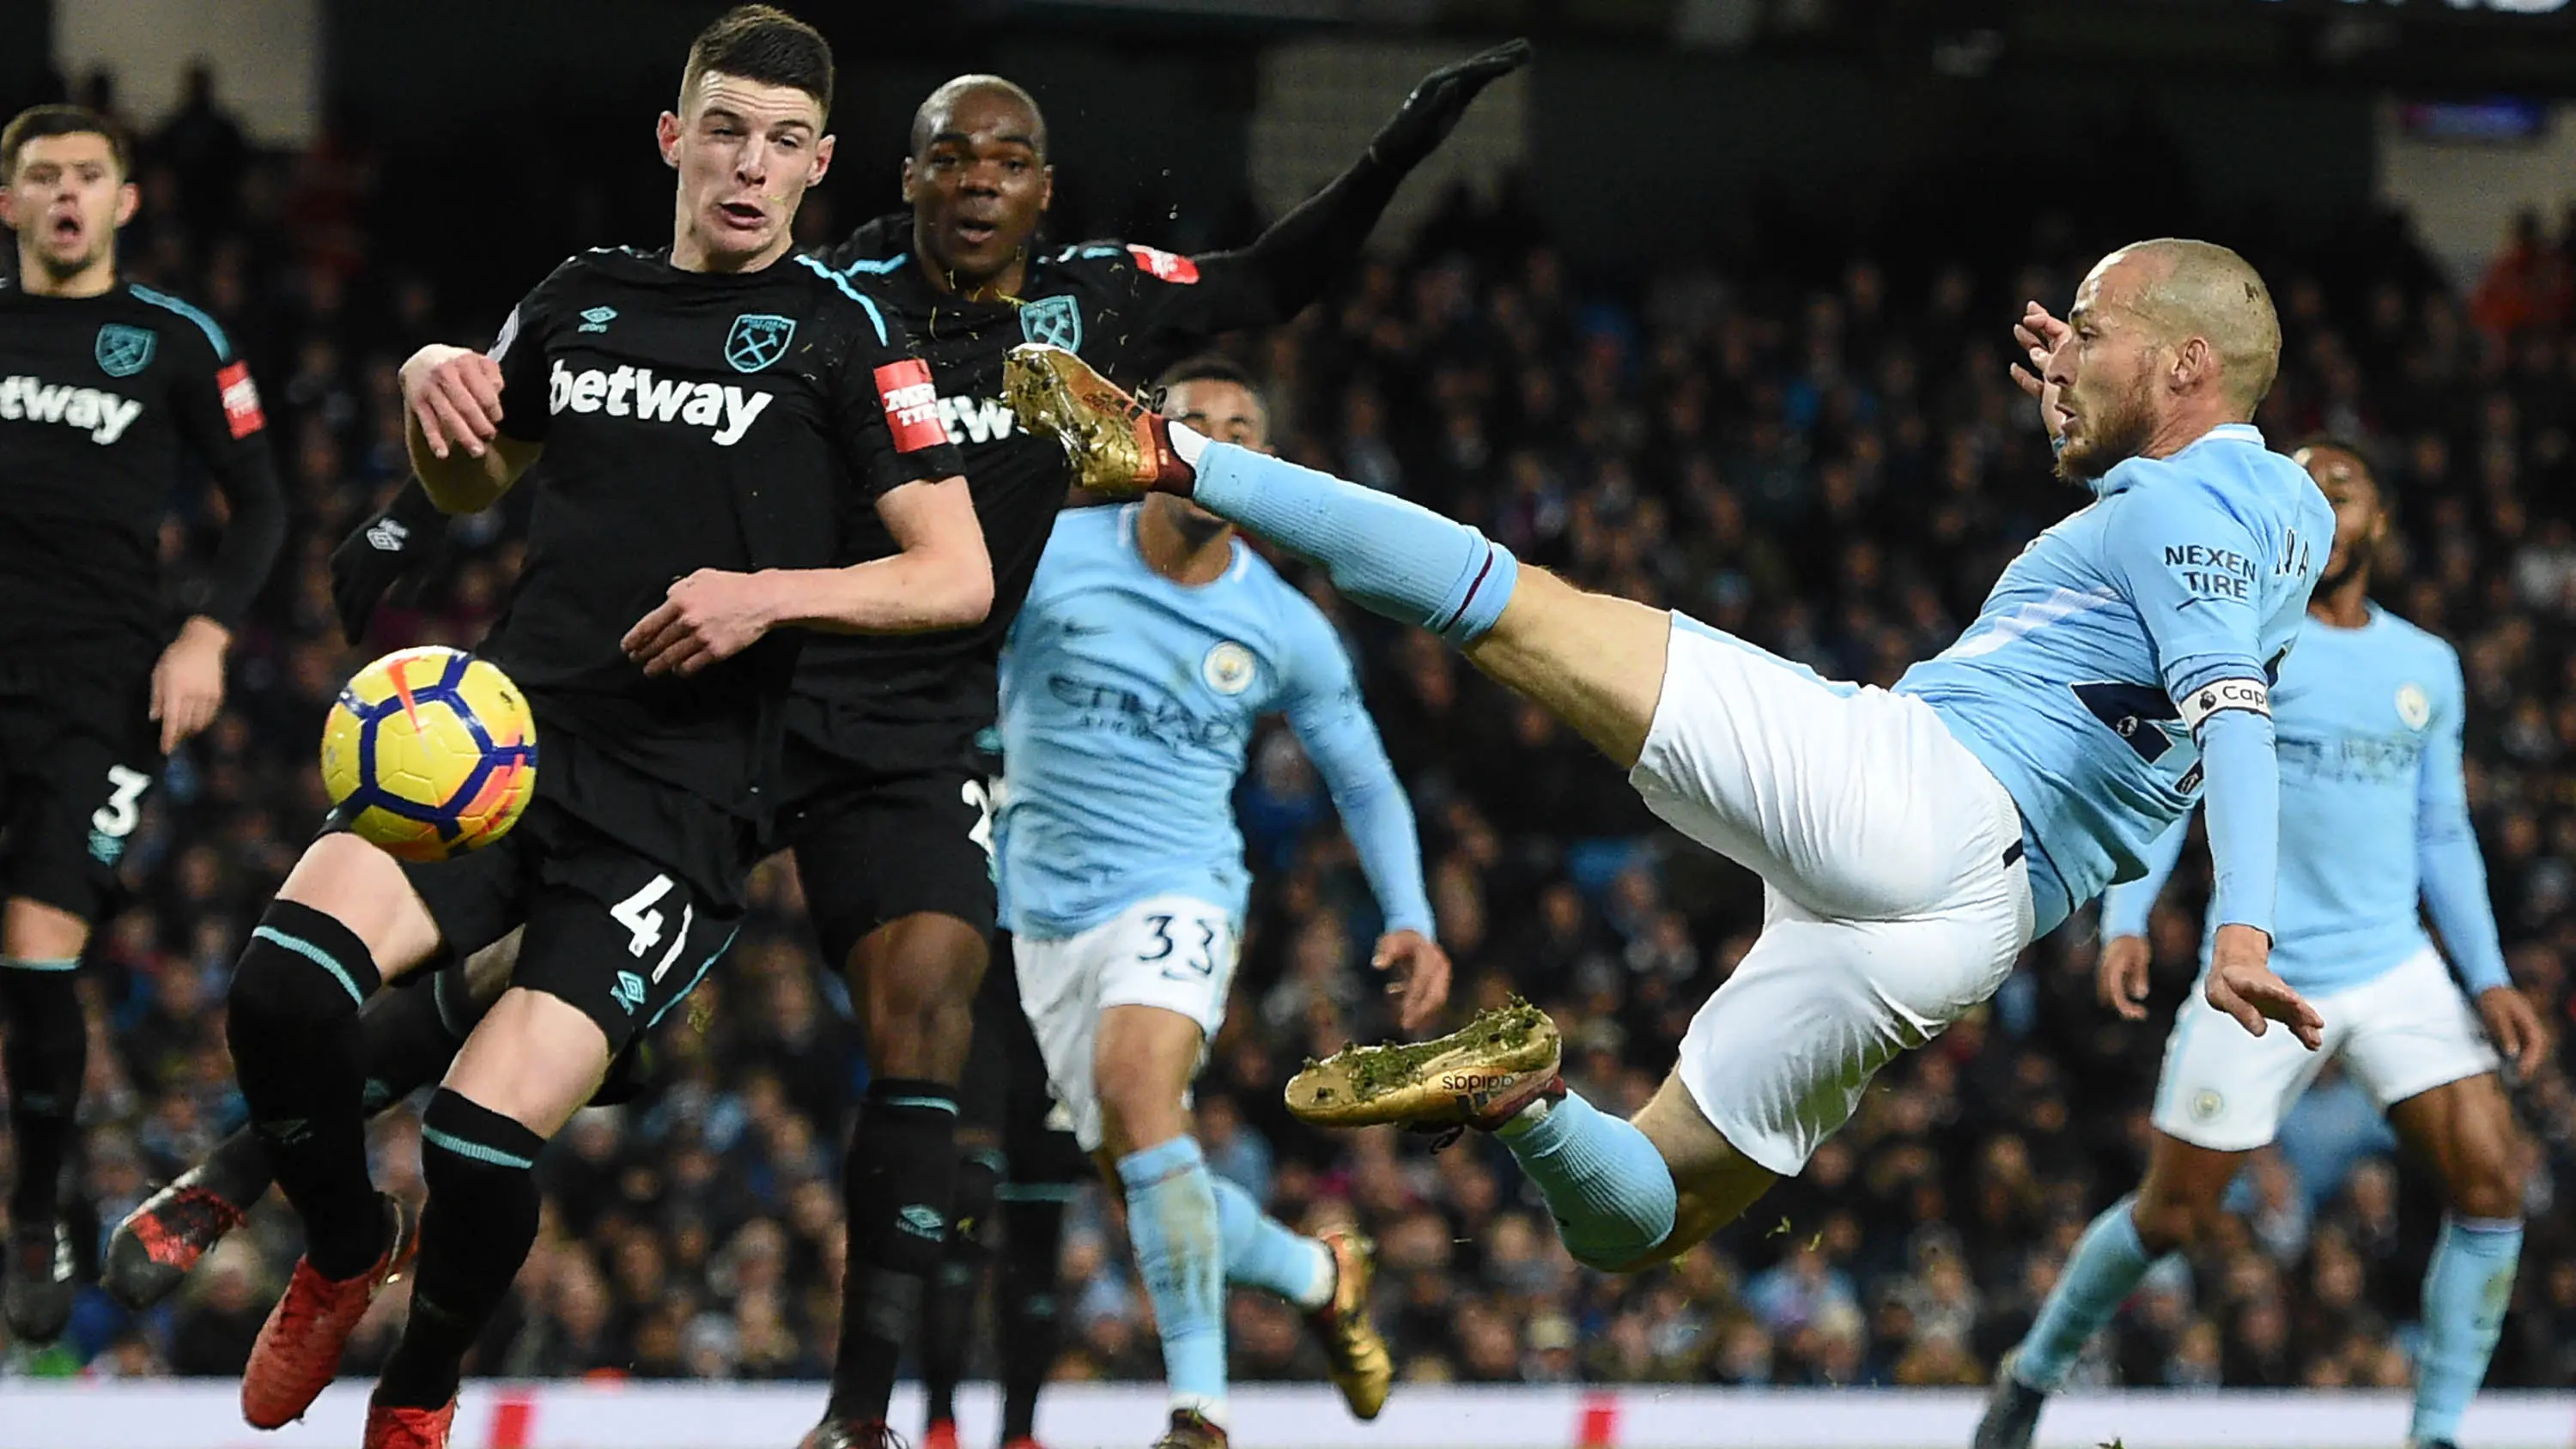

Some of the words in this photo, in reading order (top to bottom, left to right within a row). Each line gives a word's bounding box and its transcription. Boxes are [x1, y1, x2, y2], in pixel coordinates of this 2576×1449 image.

[550, 359, 774, 446] betway
[937, 394, 1030, 445] tw
[2165, 545, 2256, 583] NEXEN
[2182, 571, 2248, 601] TIRE
[2222, 686, 2269, 706] Cap
[92, 763, 153, 838] 3
[610, 873, 694, 985] 41
[1139, 915, 1214, 975] 33
[1443, 1073, 1515, 1093] adidas
